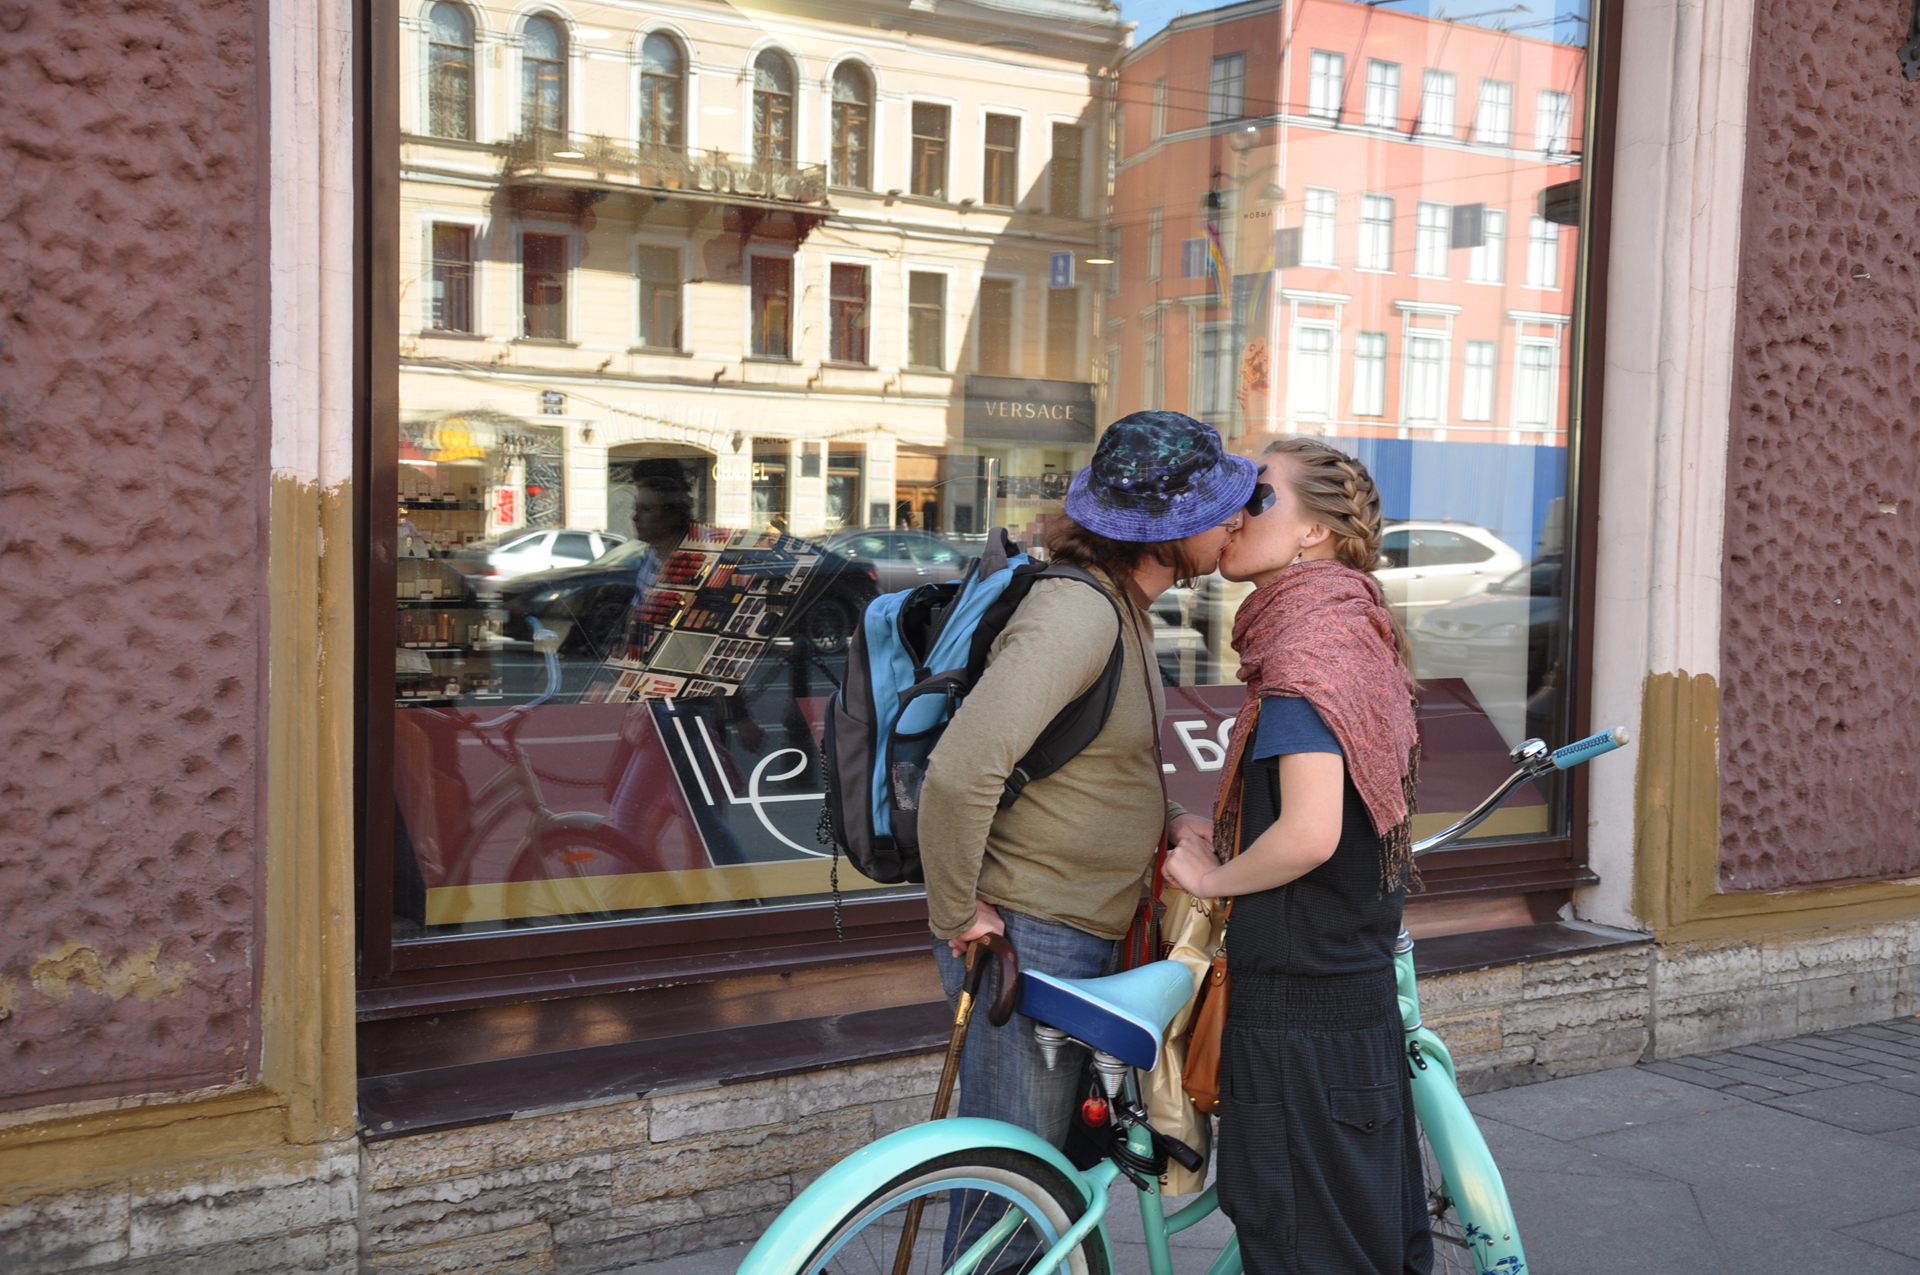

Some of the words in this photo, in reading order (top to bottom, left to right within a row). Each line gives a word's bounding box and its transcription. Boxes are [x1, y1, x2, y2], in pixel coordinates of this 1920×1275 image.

[1243, 207, 1273, 220] НОВЫЙ
[985, 400, 1075, 420] VERSACE
[711, 462, 769, 481] CHANEL
